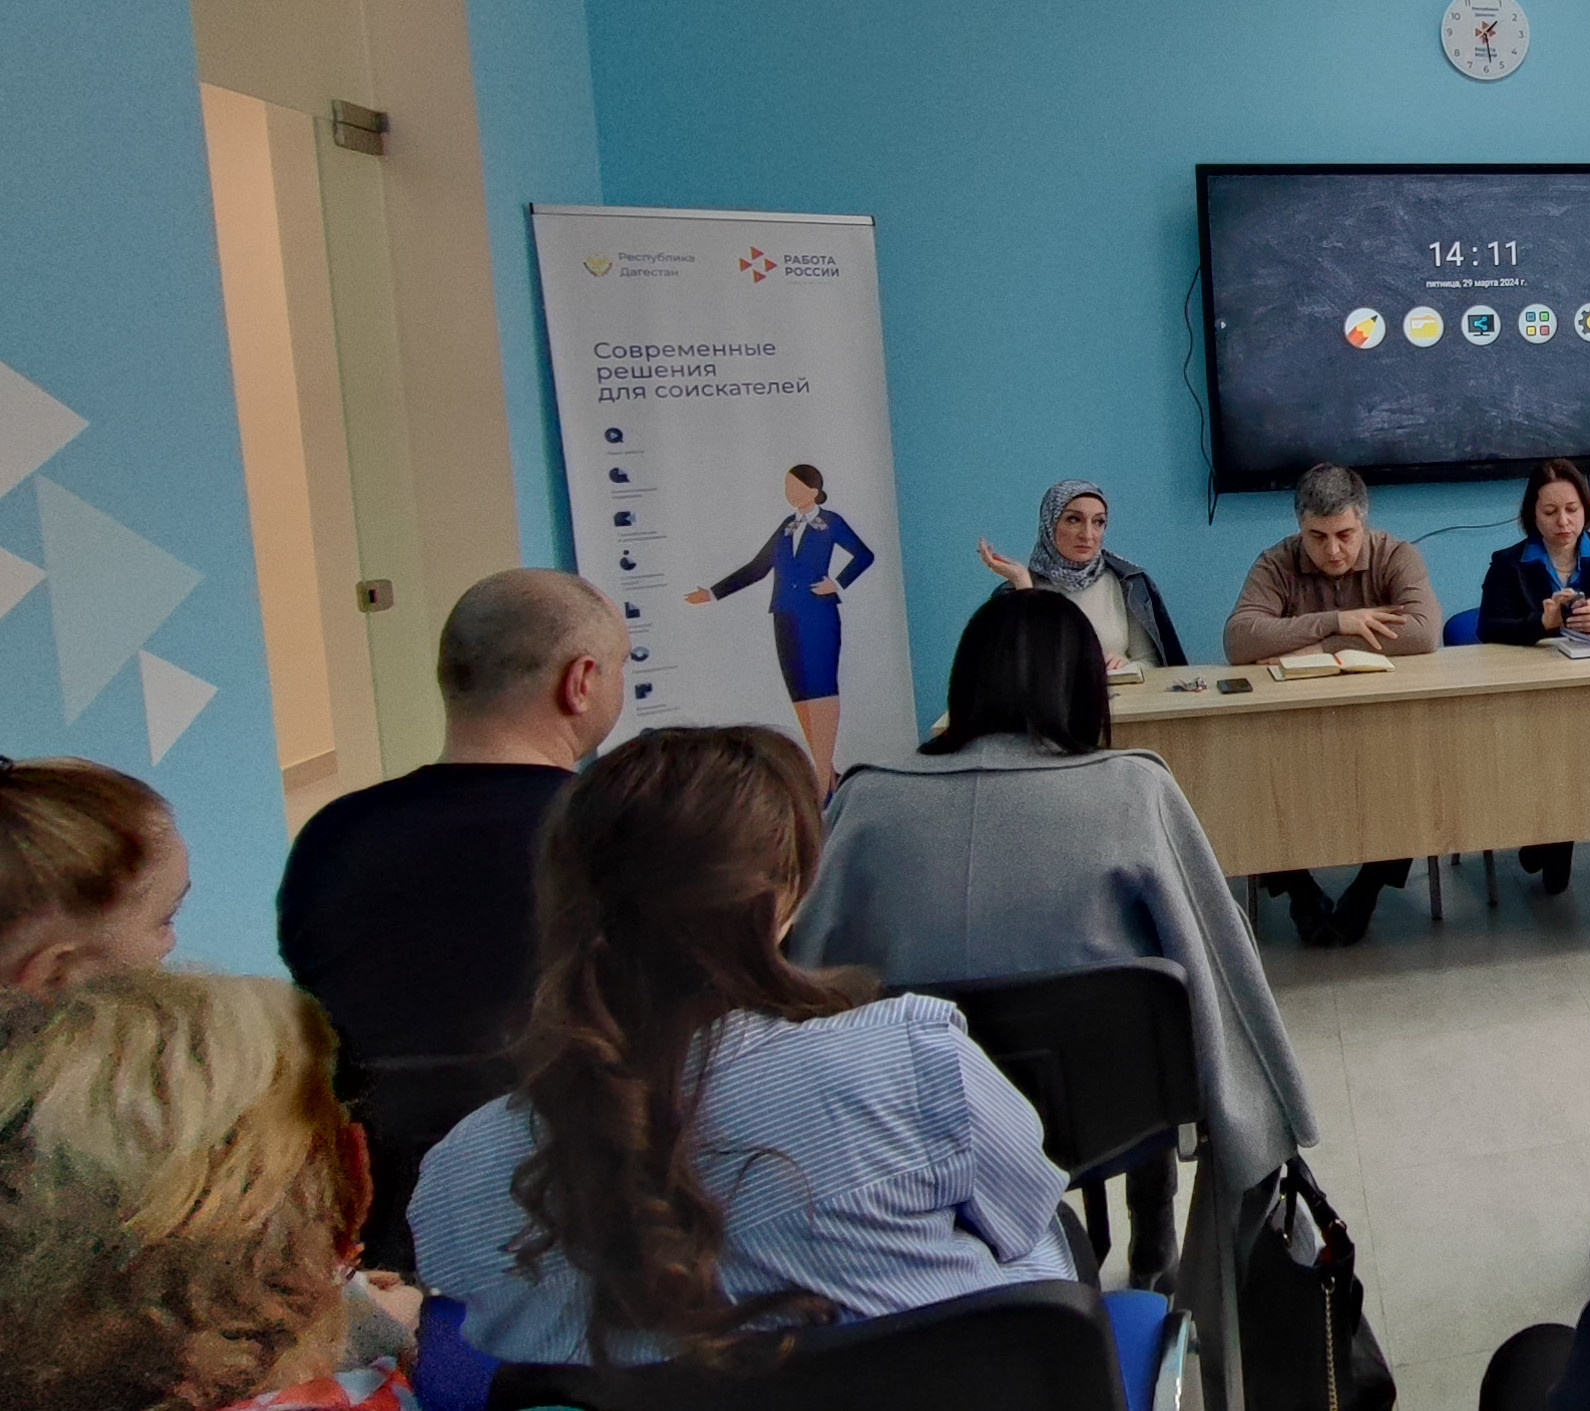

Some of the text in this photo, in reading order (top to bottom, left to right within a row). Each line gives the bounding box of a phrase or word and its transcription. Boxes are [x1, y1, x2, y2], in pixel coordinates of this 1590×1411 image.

[618, 252, 696, 264] Республика
[783, 254, 837, 266] РАБОТА
[619, 267, 679, 278] Дагестан
[785, 266, 840, 277] РОССИИ
[1426, 280, 1462, 289] пятница,
[1463, 279, 1473, 288] 29
[1474, 279, 1499, 289] марта
[1500, 278, 1519, 287] 2024
[594, 341, 777, 362] Современные
[596, 363, 717, 385] решения
[598, 377, 810, 403] для соискателей
